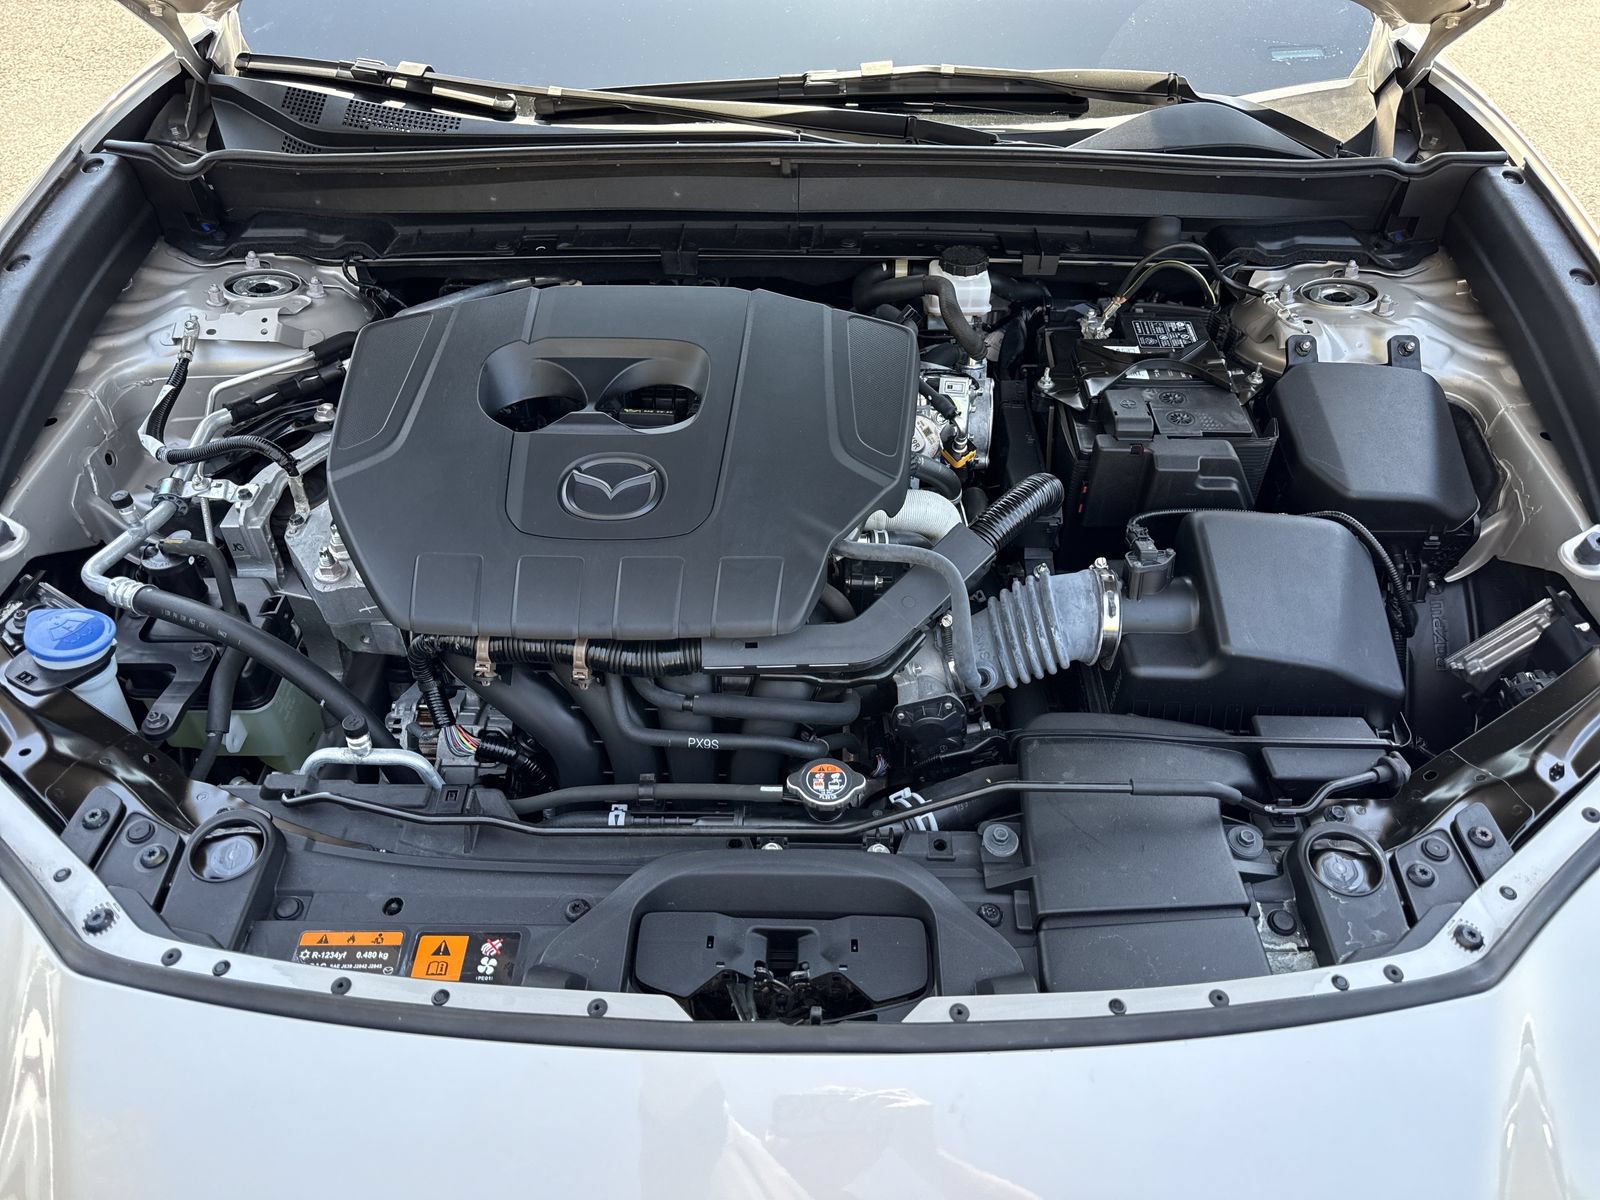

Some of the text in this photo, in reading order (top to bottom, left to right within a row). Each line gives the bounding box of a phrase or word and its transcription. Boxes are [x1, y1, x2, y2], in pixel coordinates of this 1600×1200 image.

[688, 737, 719, 750] PX9S
[311, 951, 389, 960] R-1234yf 0.480 kg
